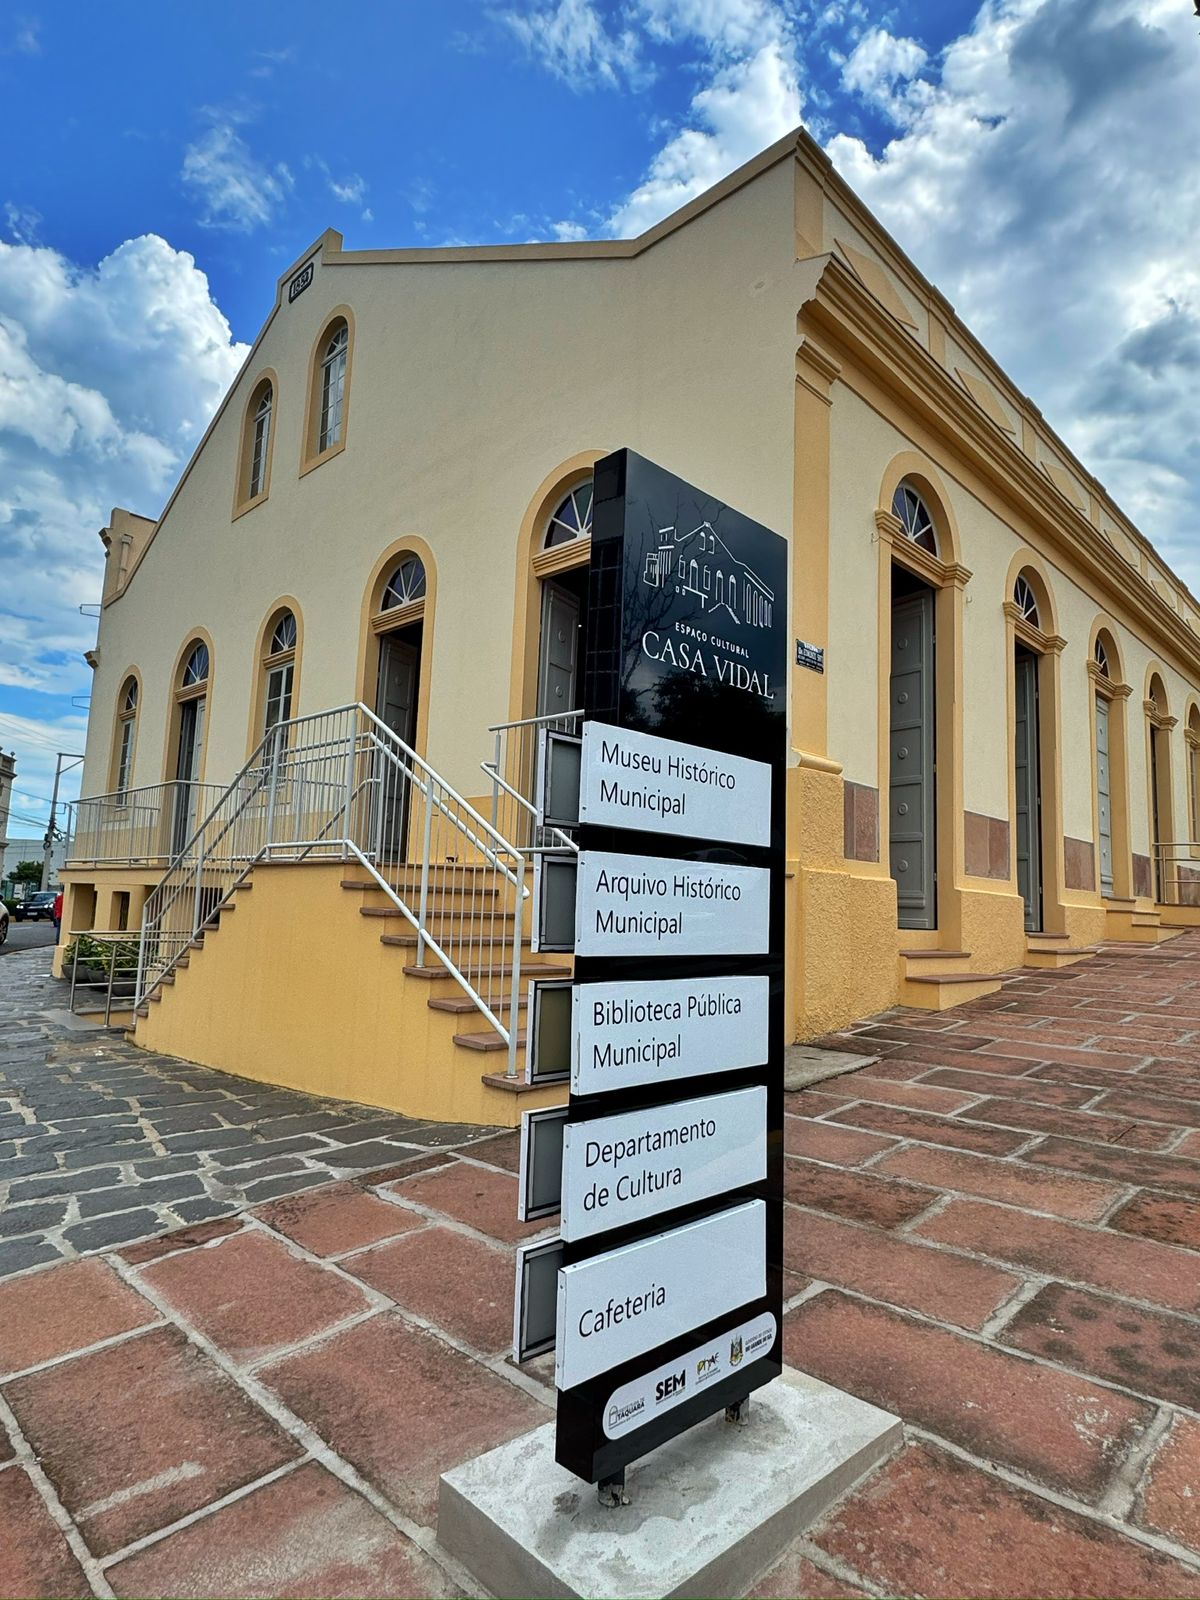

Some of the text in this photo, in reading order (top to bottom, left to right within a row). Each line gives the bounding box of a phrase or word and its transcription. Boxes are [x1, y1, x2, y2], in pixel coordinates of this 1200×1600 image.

[675, 622, 750, 658] ESPAÇO CULTURAL
[642, 630, 707, 676] CASA
[713, 655, 774, 699] VIDAL
[601, 740, 736, 790] Museu Histórico
[600, 779, 686, 818] Municipal
[596, 870, 741, 902] Arquivo Histórico
[595, 910, 682, 940] Municipal
[593, 993, 742, 1026] Biblioteca Pública
[593, 1034, 681, 1069] Municipal
[585, 1119, 716, 1168] Departamento
[584, 1167, 682, 1211] de Cultura
[579, 1283, 666, 1338] Cafeteria
[655, 1369, 686, 1401] SEM
[617, 1401, 645, 1421] TAQUARA
